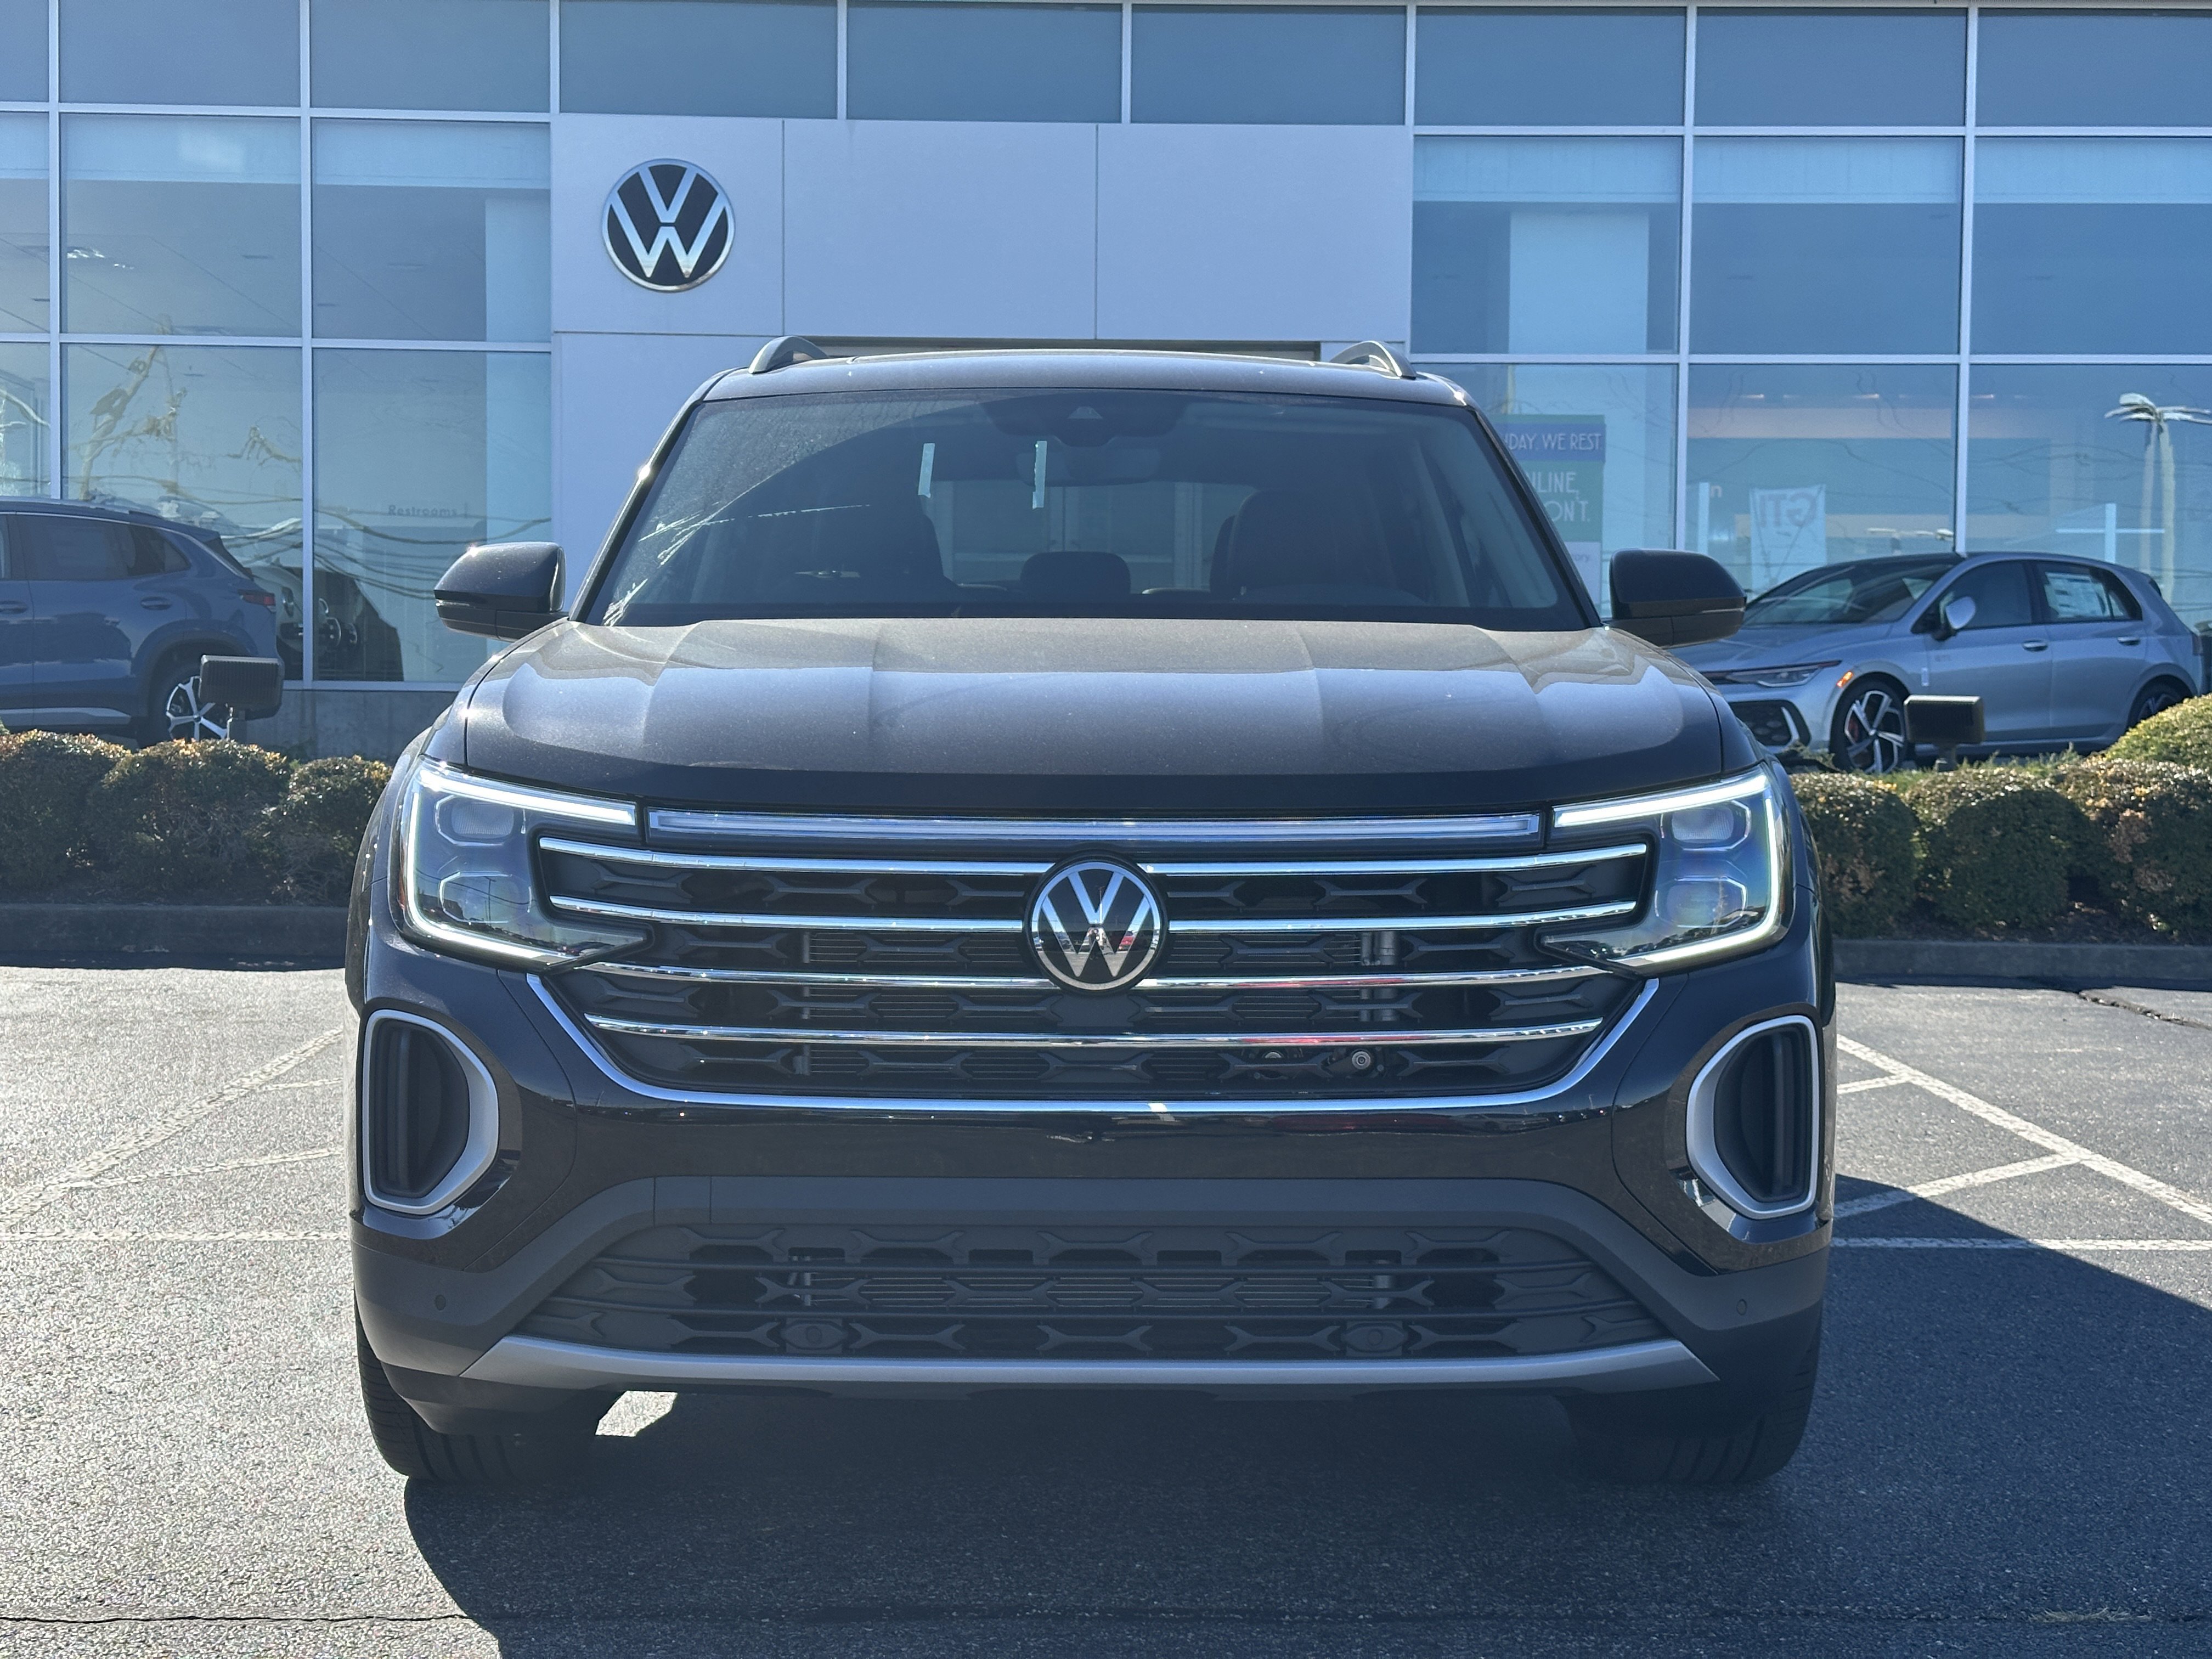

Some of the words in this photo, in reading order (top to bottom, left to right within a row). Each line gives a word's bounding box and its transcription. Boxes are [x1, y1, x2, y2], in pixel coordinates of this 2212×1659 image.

[603, 160, 733, 287] VW
[1542, 433, 1566, 450] WE
[388, 504, 457, 517] Restrooms
[1032, 863, 1159, 985] VW
